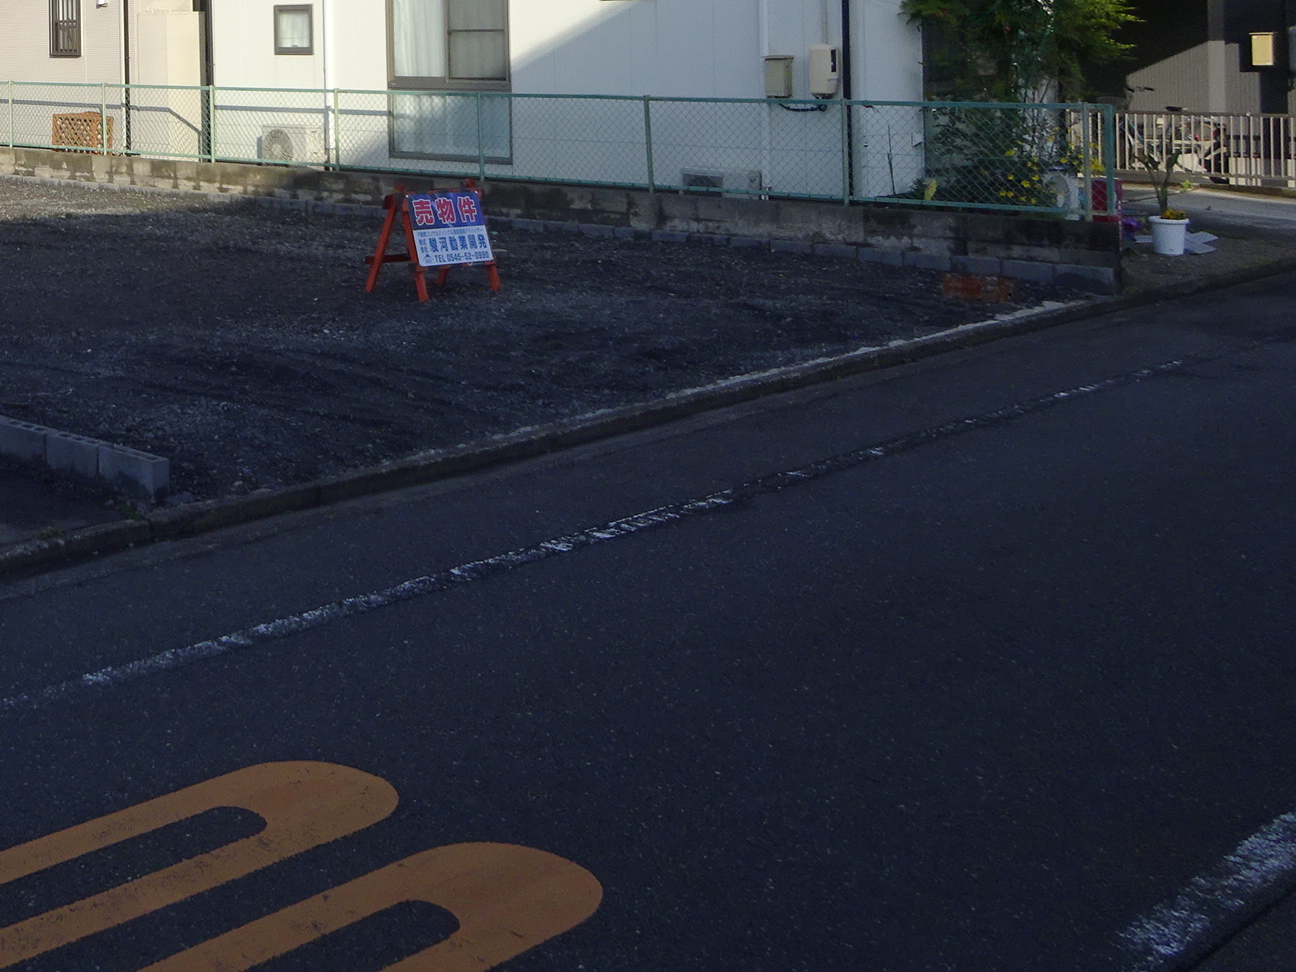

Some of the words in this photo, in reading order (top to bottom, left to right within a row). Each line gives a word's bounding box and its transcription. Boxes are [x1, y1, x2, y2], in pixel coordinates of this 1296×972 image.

[412, 196, 477, 225] 売物件
[435, 254, 446, 262] TEL
